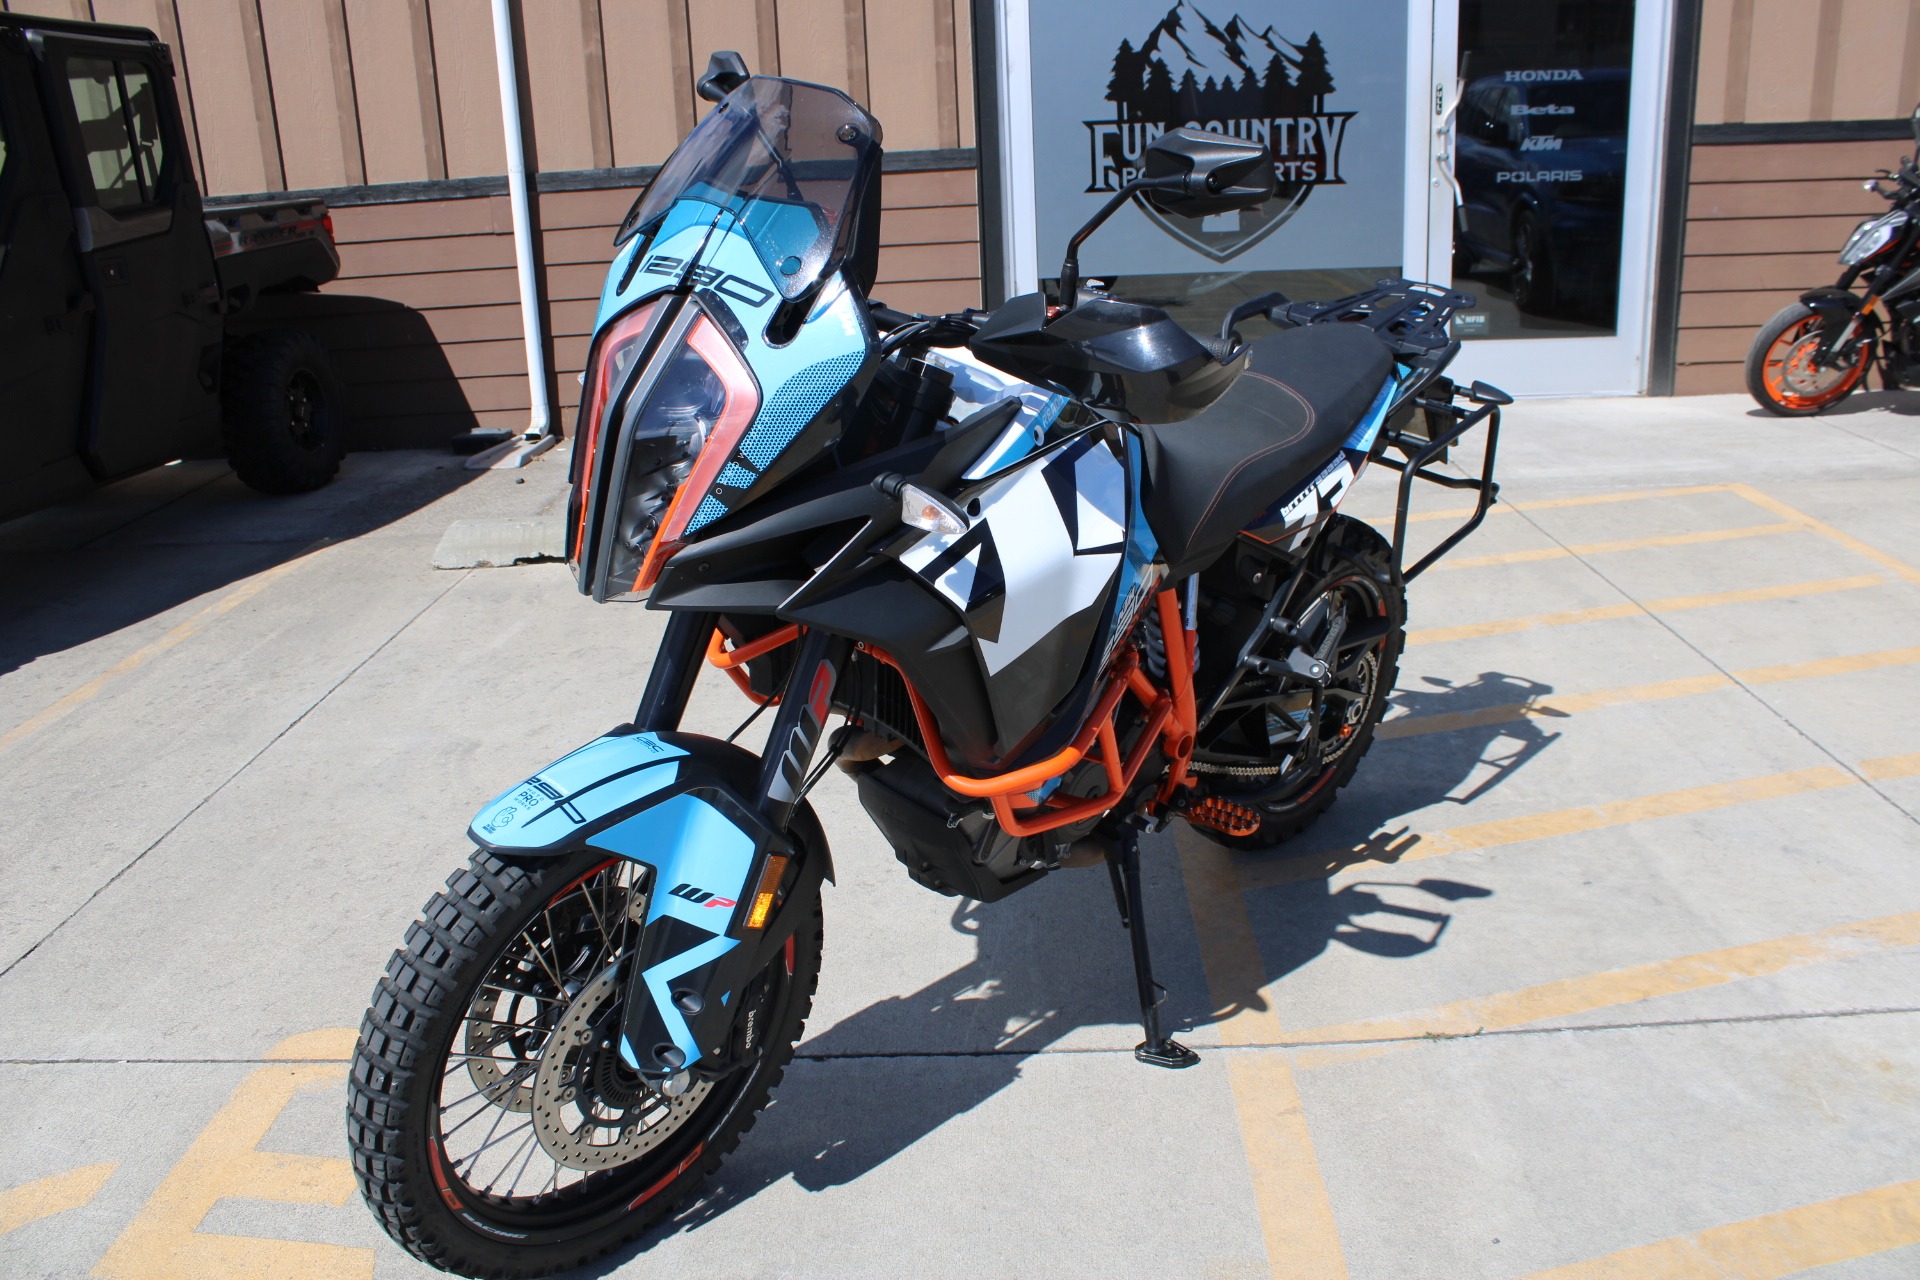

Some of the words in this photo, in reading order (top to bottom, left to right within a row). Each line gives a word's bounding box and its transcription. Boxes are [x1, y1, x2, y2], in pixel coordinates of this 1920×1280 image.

[1504, 69, 1583, 82] HONDA
[1510, 104, 1575, 115] Beta
[1520, 135, 1563, 151] KTM
[1496, 170, 1583, 183] POLARIS
[517, 791, 539, 807] PRO
[667, 883, 738, 908] WP
[745, 1009, 757, 1049] brembo
